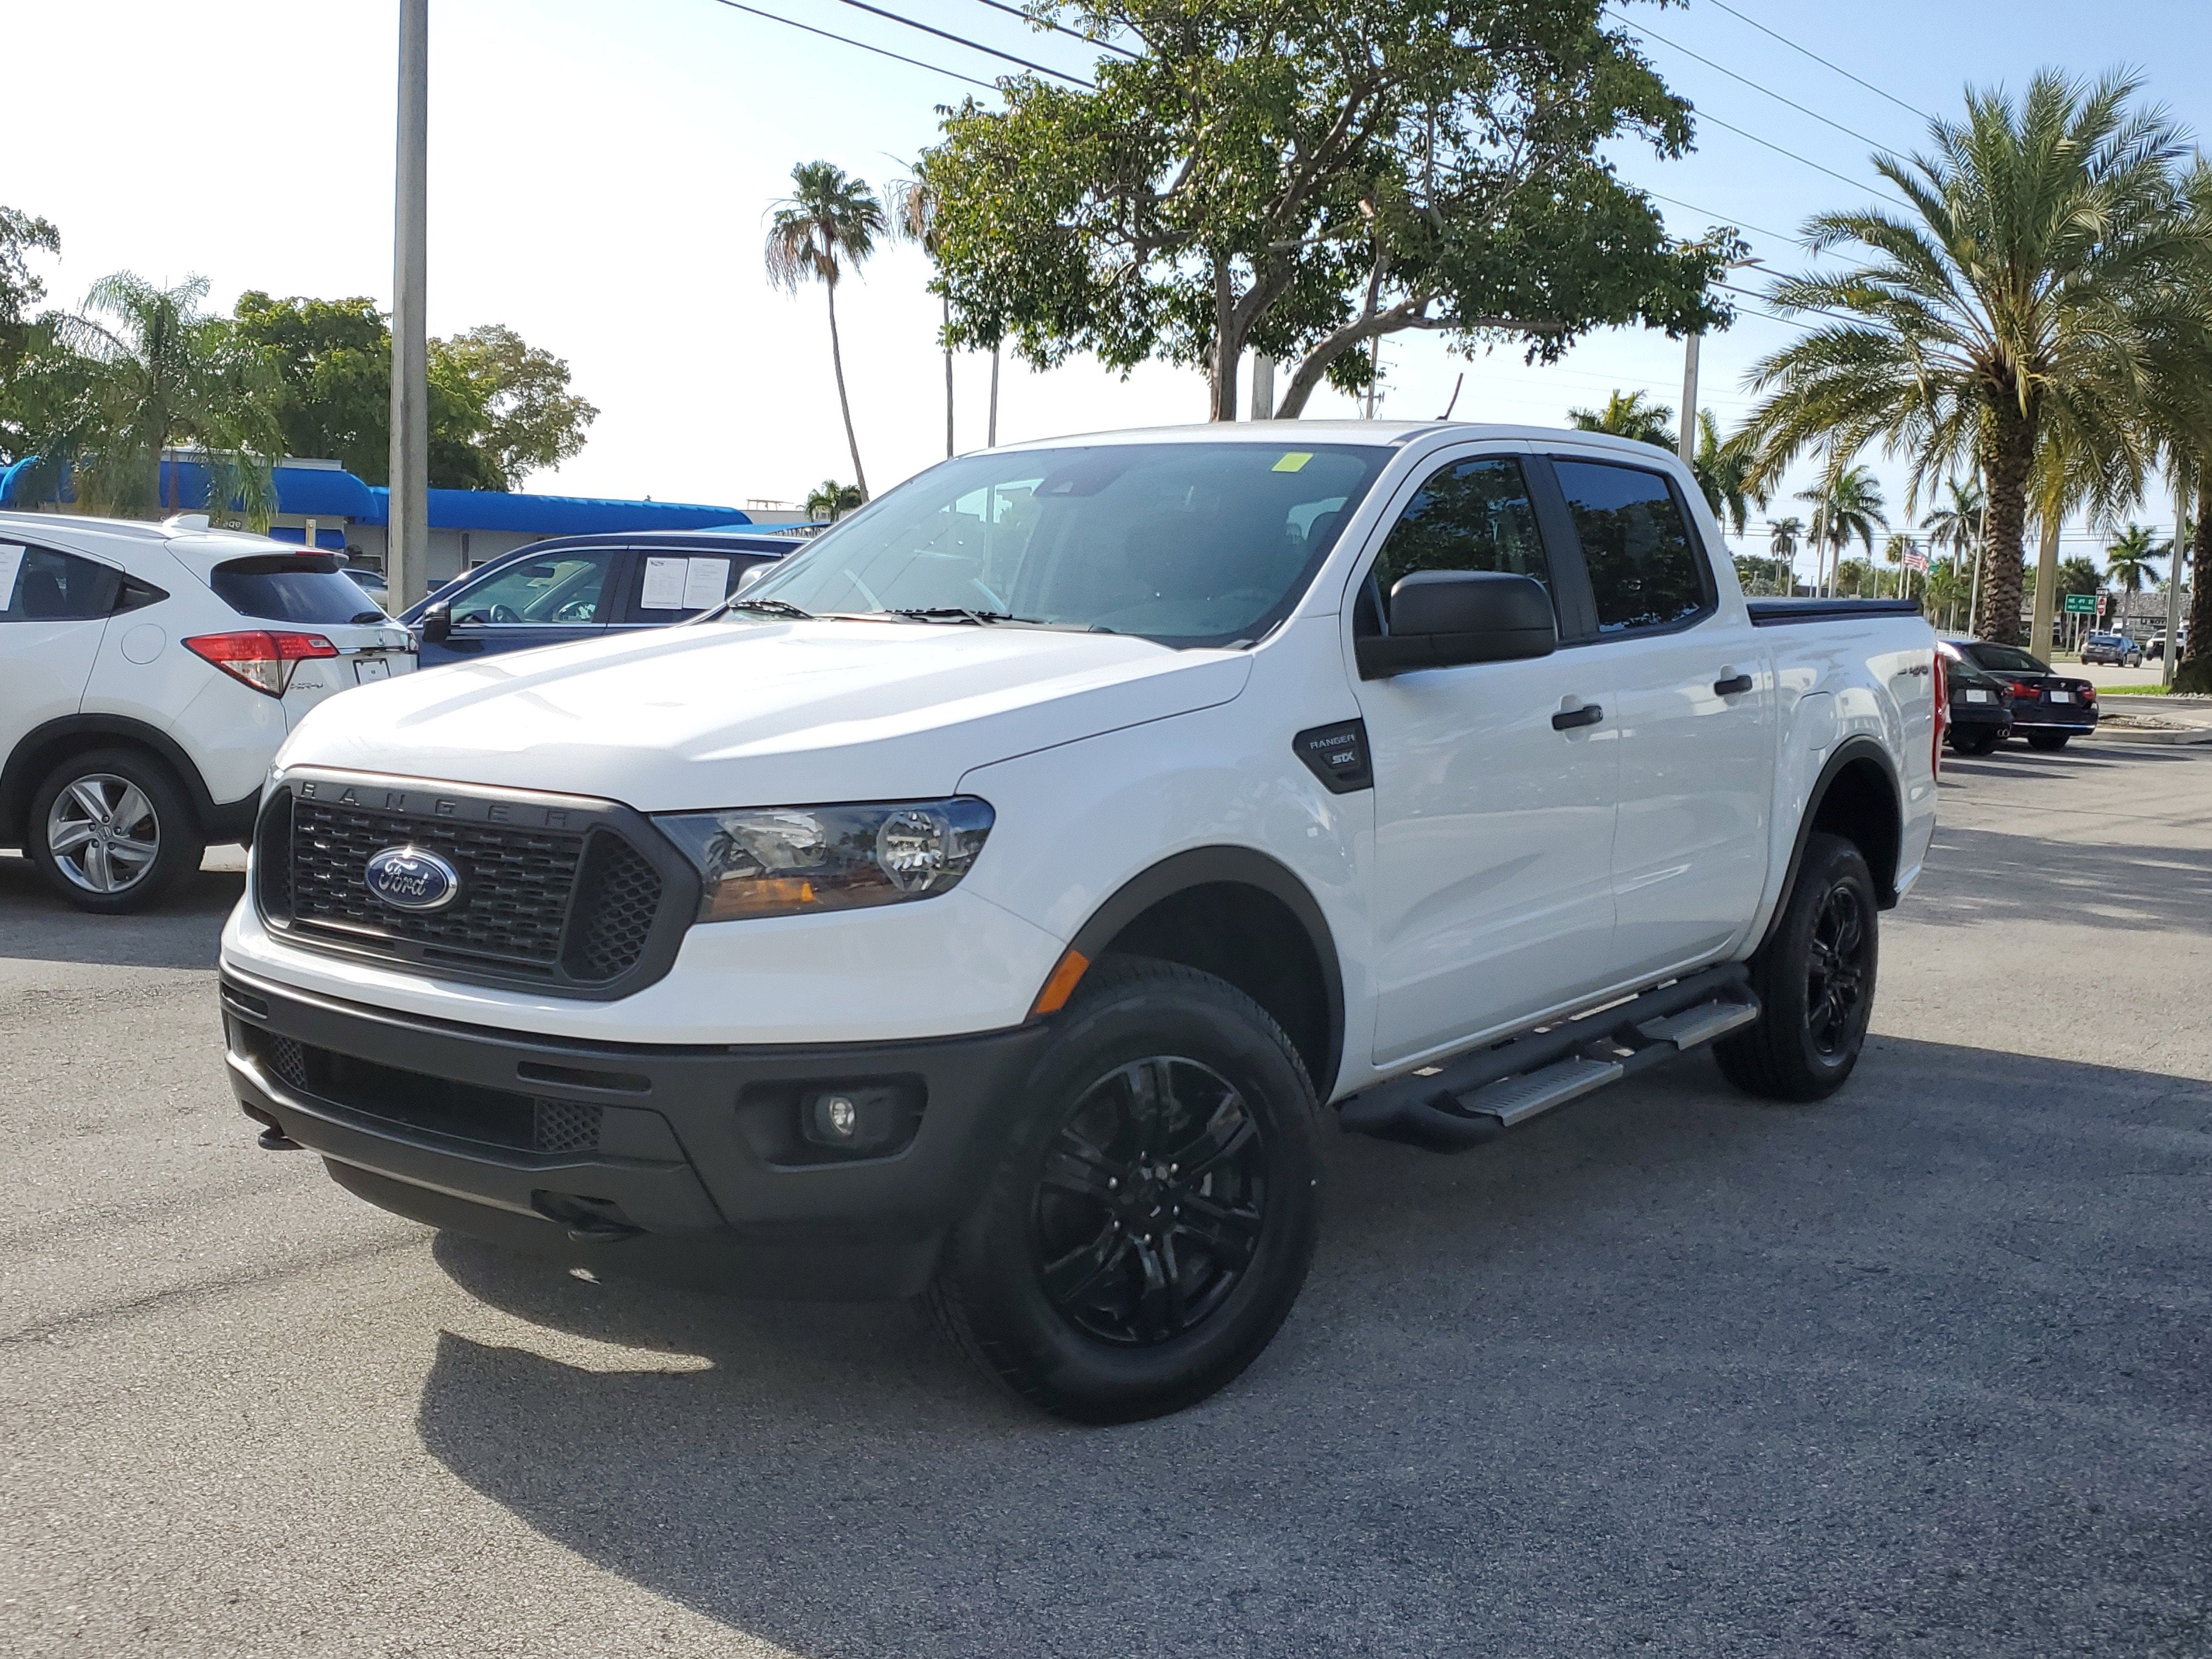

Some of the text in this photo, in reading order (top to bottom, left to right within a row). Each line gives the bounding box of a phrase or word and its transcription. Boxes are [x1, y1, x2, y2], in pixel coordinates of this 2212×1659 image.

[1310, 733, 1355, 750] RANGER
[1331, 751, 1355, 765] STX
[301, 781, 568, 828] RANGER
[378, 857, 430, 897] Ford
